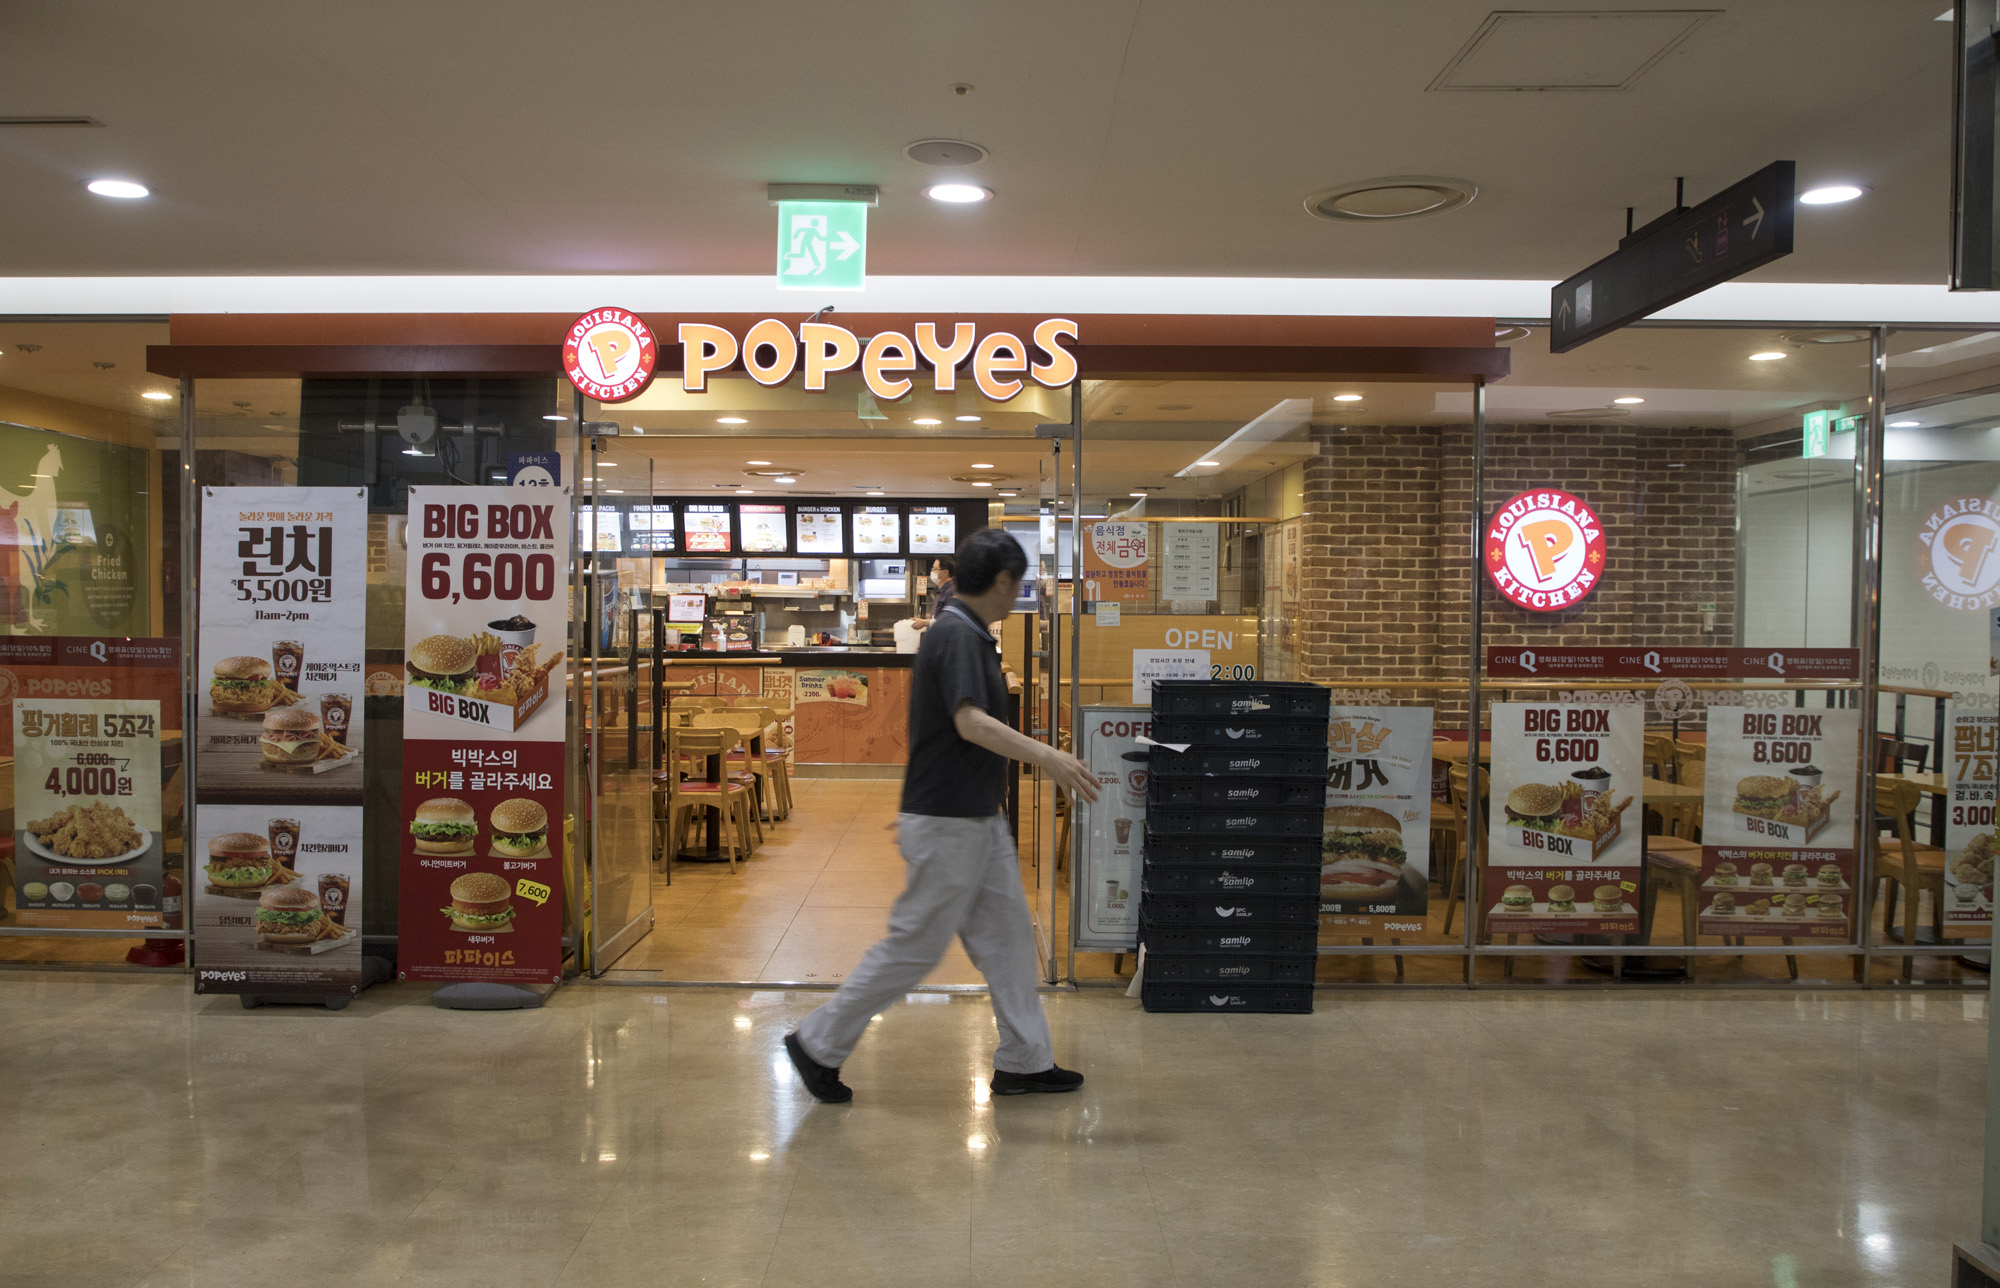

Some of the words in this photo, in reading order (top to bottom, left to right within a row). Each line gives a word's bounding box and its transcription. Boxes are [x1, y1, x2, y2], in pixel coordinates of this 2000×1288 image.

[567, 310, 652, 349] LOUISIANA
[569, 367, 648, 399] KITCHEN
[518, 456, 549, 465] 파파이스
[239, 512, 265, 522] 놀라운
[266, 512, 285, 522] 맛에
[287, 512, 313, 522] 놀라운
[315, 512, 333, 522] 가격
[926, 506, 948, 514] BURGER
[1490, 493, 1600, 544] LOUISIANA
[424, 504, 479, 540] BIG
[487, 504, 554, 540] BOX
[1095, 525, 1125, 537] 음식점
[238, 525, 333, 577] 런치
[97, 554, 121, 567] Fried
[91, 568, 127, 580] Chicken
[421, 552, 555, 605] 6,600
[237, 578, 332, 604] 5,500원
[1493, 566, 1595, 607] KITCHEN
[255, 610, 309, 622] 11am-2pm
[1165, 628, 1233, 650] OPEN
[66, 646, 88, 654] CINE
[1494, 656, 1517, 664] CINE
[1619, 656, 1642, 664] CINE
[1743, 657, 1766, 665] CINE
[305, 672, 337, 682] 치킨버거
[428, 691, 455, 716] BIG
[458, 698, 490, 724] BOX
[22, 709, 98, 738] 핑거휠레
[103, 714, 155, 738] 5조각
[1100, 721, 1152, 738] COFF
[1524, 709, 1561, 732] BIG
[1567, 709, 1610, 732] BOX
[1743, 713, 1777, 735] BIG
[1782, 714, 1822, 736] BOX
[50, 739, 69, 747] 100%
[1327, 721, 1392, 753] 안심
[1954, 725, 1999, 752] 팝너
[451, 749, 518, 768] 빅박스의
[1536, 738, 1599, 764] 6,600
[1753, 741, 1812, 764] 8,600
[1229, 759, 1260, 768] samlip
[1955, 754, 1998, 781] 7조
[45, 767, 133, 798] 4,000원
[415, 770, 465, 790] 버거를
[469, 772, 553, 791] 골라주세요
[1227, 788, 1259, 797] samlip
[1225, 817, 1257, 826] samlip
[1746, 817, 1765, 834] BIG
[1767, 822, 1789, 840] BOX
[1522, 829, 1544, 849] BIG
[1547, 836, 1573, 856] BOX
[1221, 849, 1254, 857] samlip
[1717, 850, 1747, 859] 빅박스의
[1748, 850, 1764, 859] 버거
[1764, 851, 1775, 859] OR
[1800, 851, 1836, 861] 골라주세요
[420, 859, 467, 869] 어니언미트버거
[503, 861, 537, 870] 불고기버거
[1223, 877, 1254, 886] samlip
[1506, 870, 1543, 881] 빅박스의
[1546, 870, 1574, 881] 버거를
[1575, 870, 1621, 881] 골라주세요
[518, 882, 548, 900] 7,600
[1319, 904, 1342, 912] ,200원
[467, 935, 495, 944] 새우버거
[1220, 936, 1251, 945] samlip
[444, 949, 516, 967] 파파이스
[1219, 966, 1250, 974] samlip
